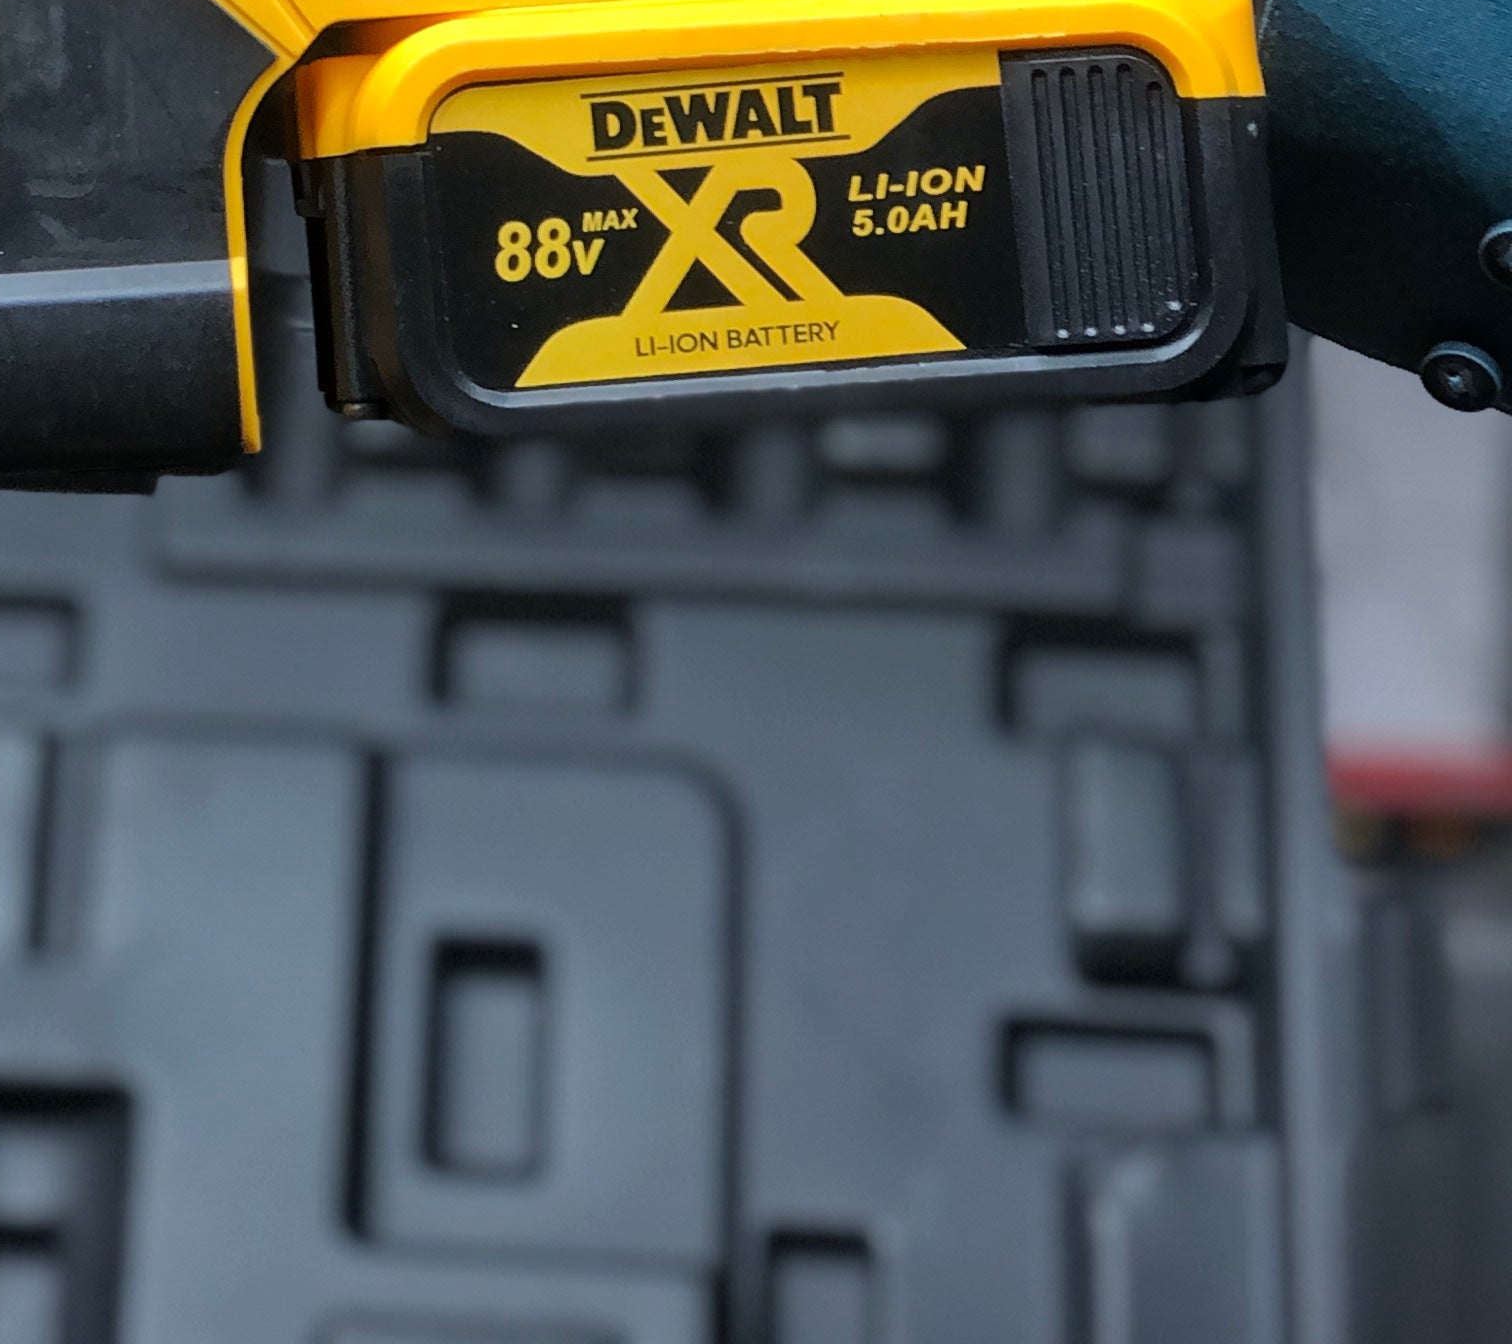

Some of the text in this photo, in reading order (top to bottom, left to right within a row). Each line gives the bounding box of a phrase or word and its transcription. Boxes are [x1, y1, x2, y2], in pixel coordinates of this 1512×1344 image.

[848, 165, 986, 203] LI-ION
[581, 207, 639, 233] MAX
[618, 160, 846, 315] XR
[851, 199, 969, 238] 5.0AH
[635, 319, 841, 358] LI-ION BATTERY
